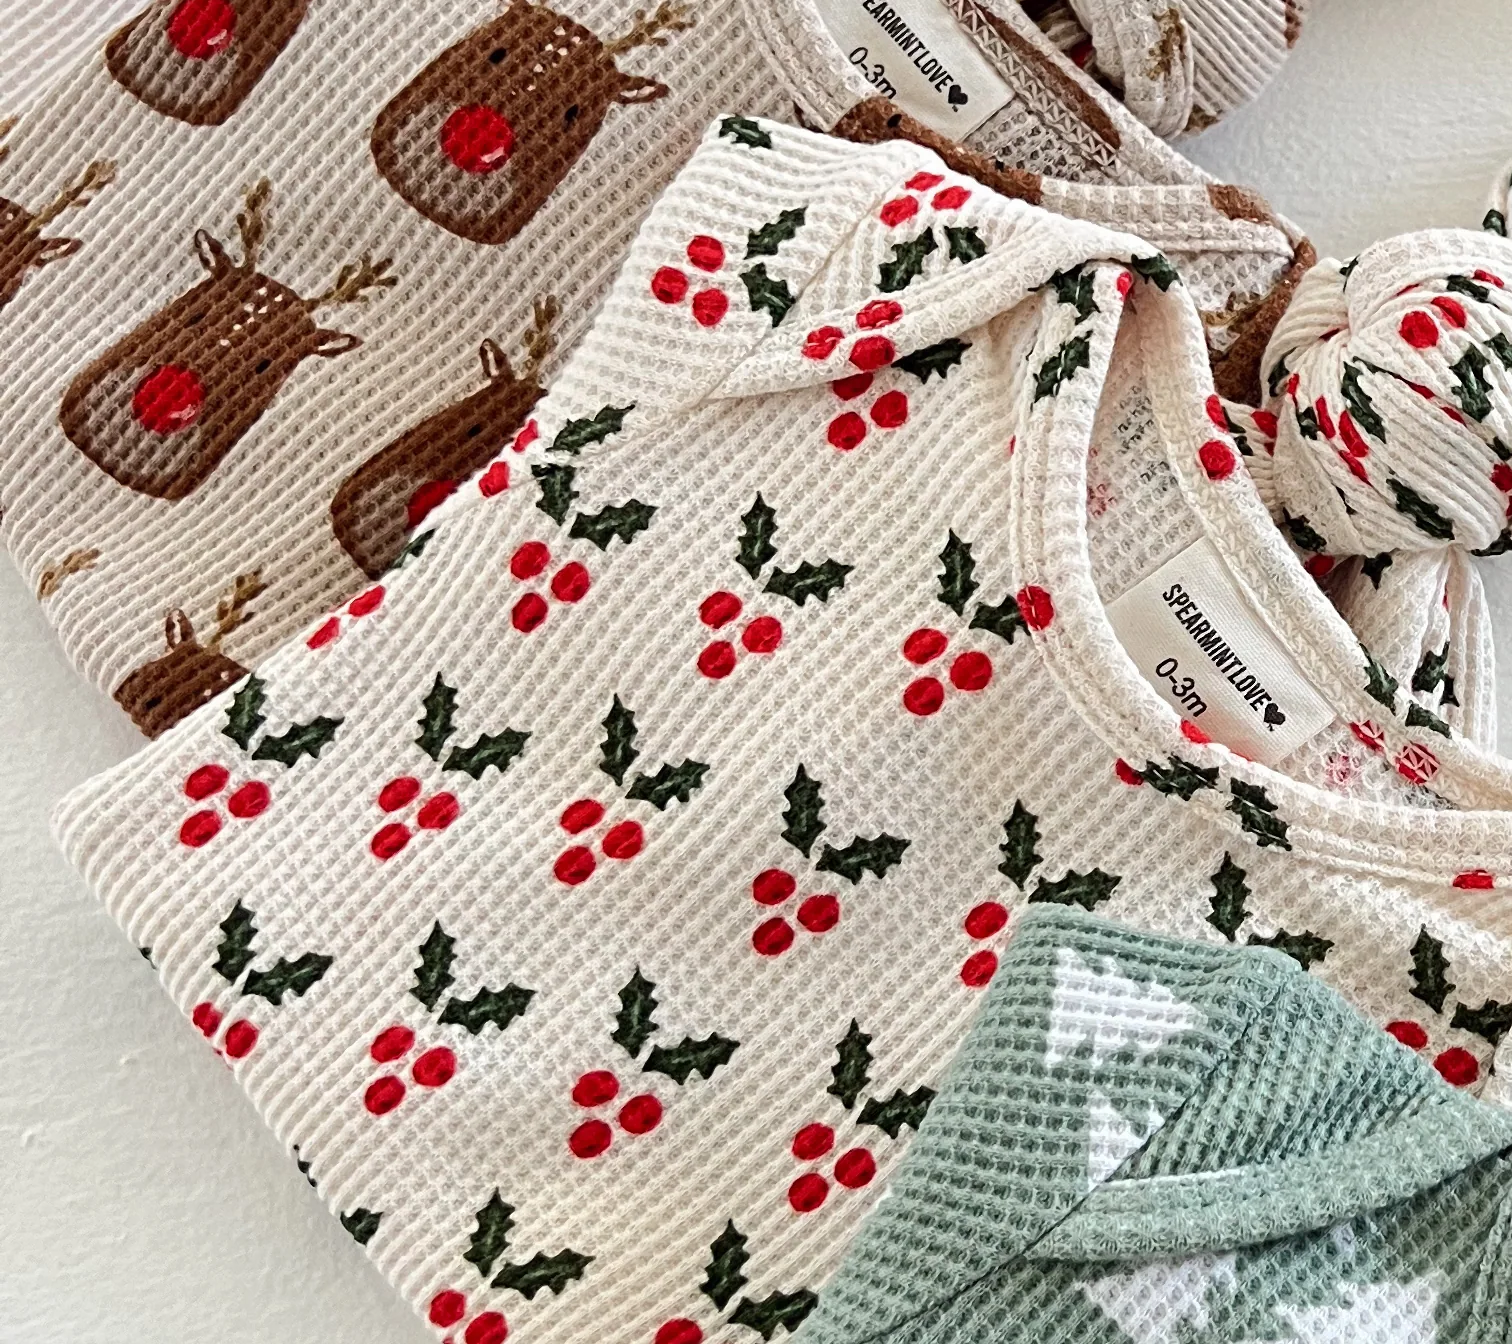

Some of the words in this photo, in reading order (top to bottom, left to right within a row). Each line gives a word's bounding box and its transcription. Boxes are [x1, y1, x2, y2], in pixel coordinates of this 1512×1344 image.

[850, 47, 897, 99] 0-3m
[1163, 584, 1272, 712] SPEARMINTLOVE
[1155, 658, 1208, 718] 0-3m
